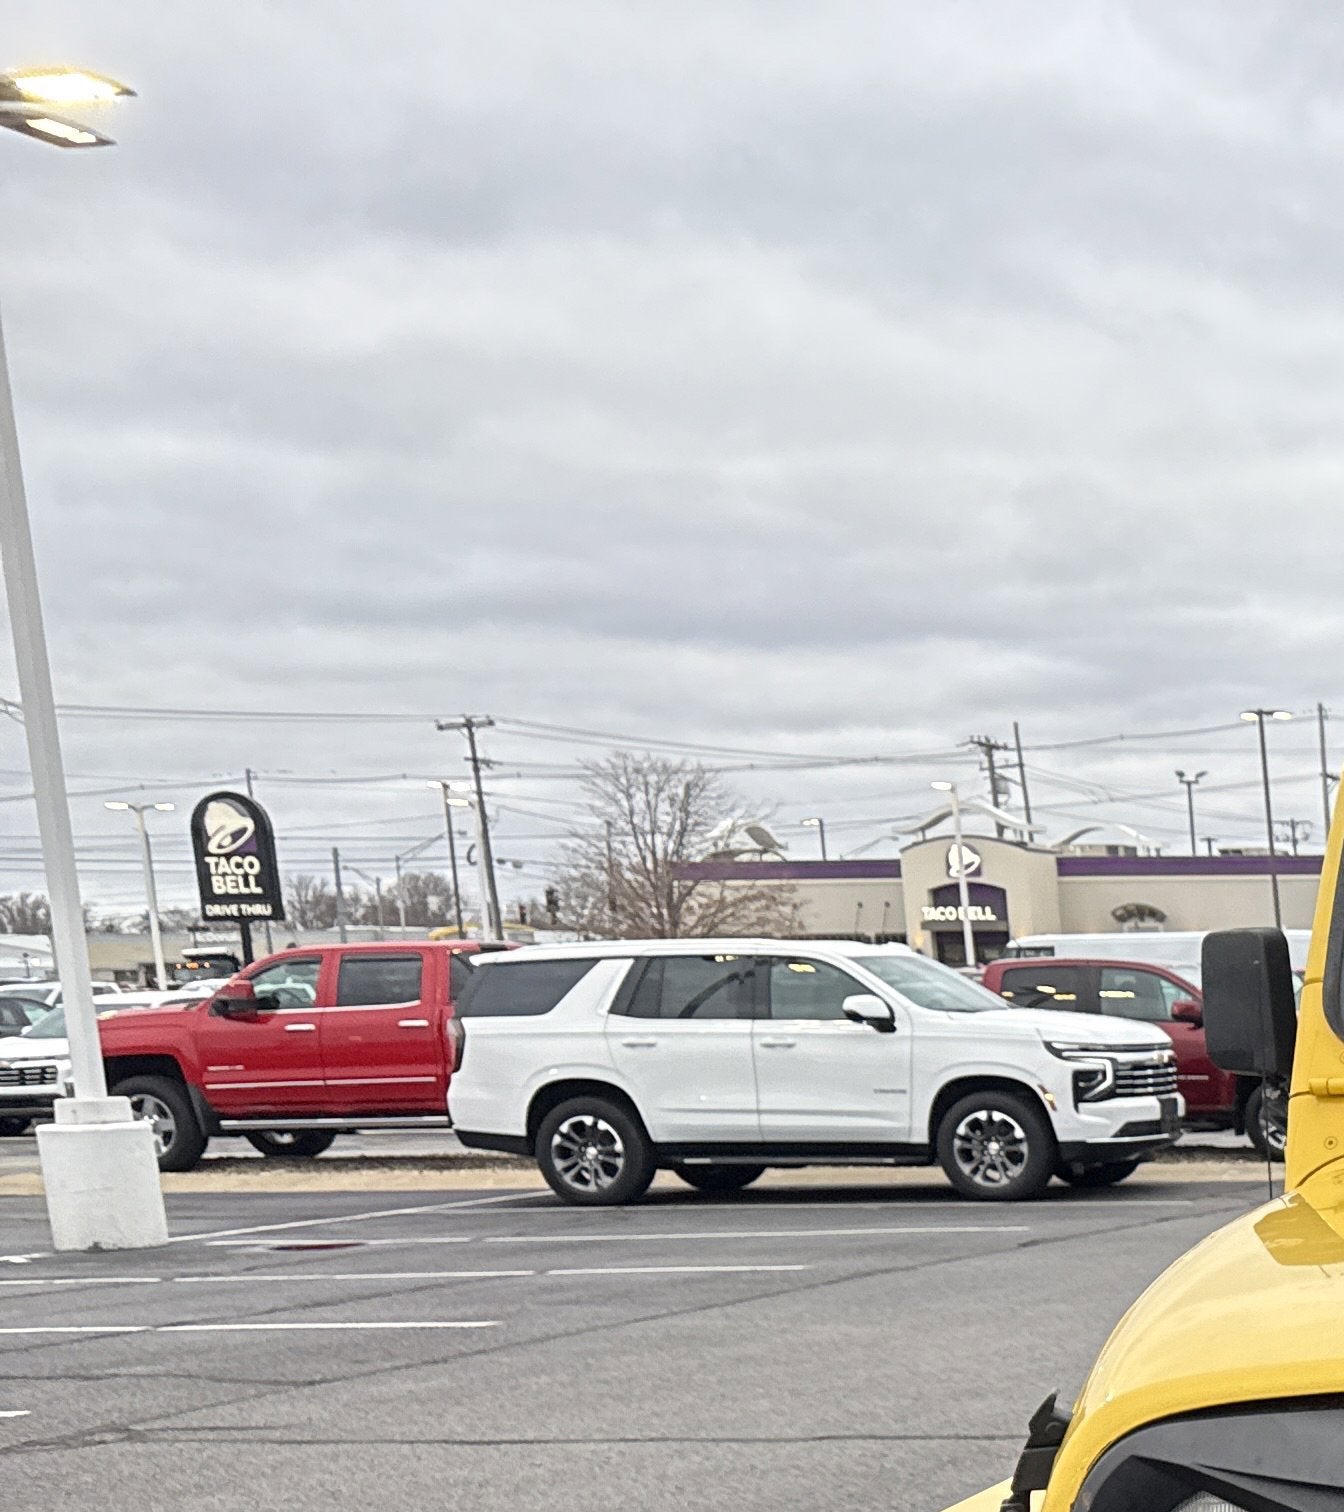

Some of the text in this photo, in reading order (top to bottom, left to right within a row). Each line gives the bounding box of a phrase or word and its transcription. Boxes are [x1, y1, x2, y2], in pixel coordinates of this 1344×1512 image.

[204, 856, 261, 875] TACO
[211, 875, 263, 895] BELL
[205, 903, 272, 917] DRIVE THRU
[921, 905, 957, 921] TACO
